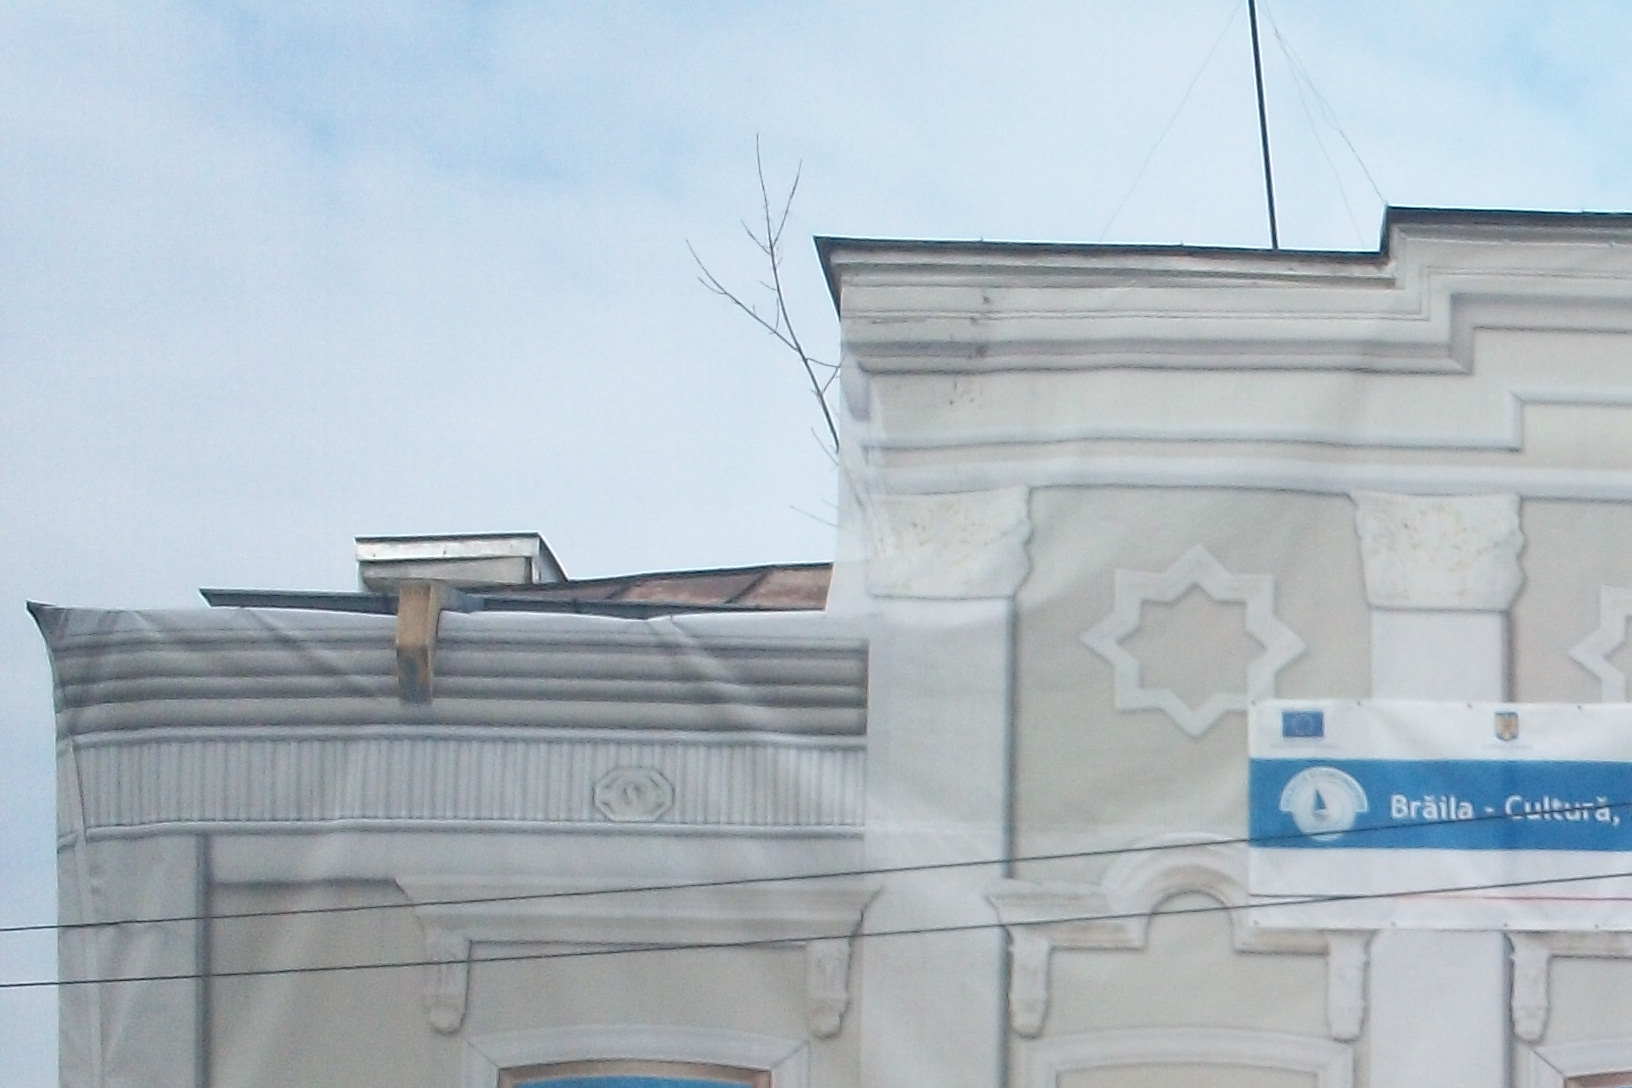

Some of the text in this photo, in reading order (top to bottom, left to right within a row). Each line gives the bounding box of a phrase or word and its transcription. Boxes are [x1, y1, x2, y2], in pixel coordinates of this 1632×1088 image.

[1390, 793, 1474, 821] Brăila
[1484, 805, 1496, 813] -
[1504, 794, 1621, 827] Cultură,
